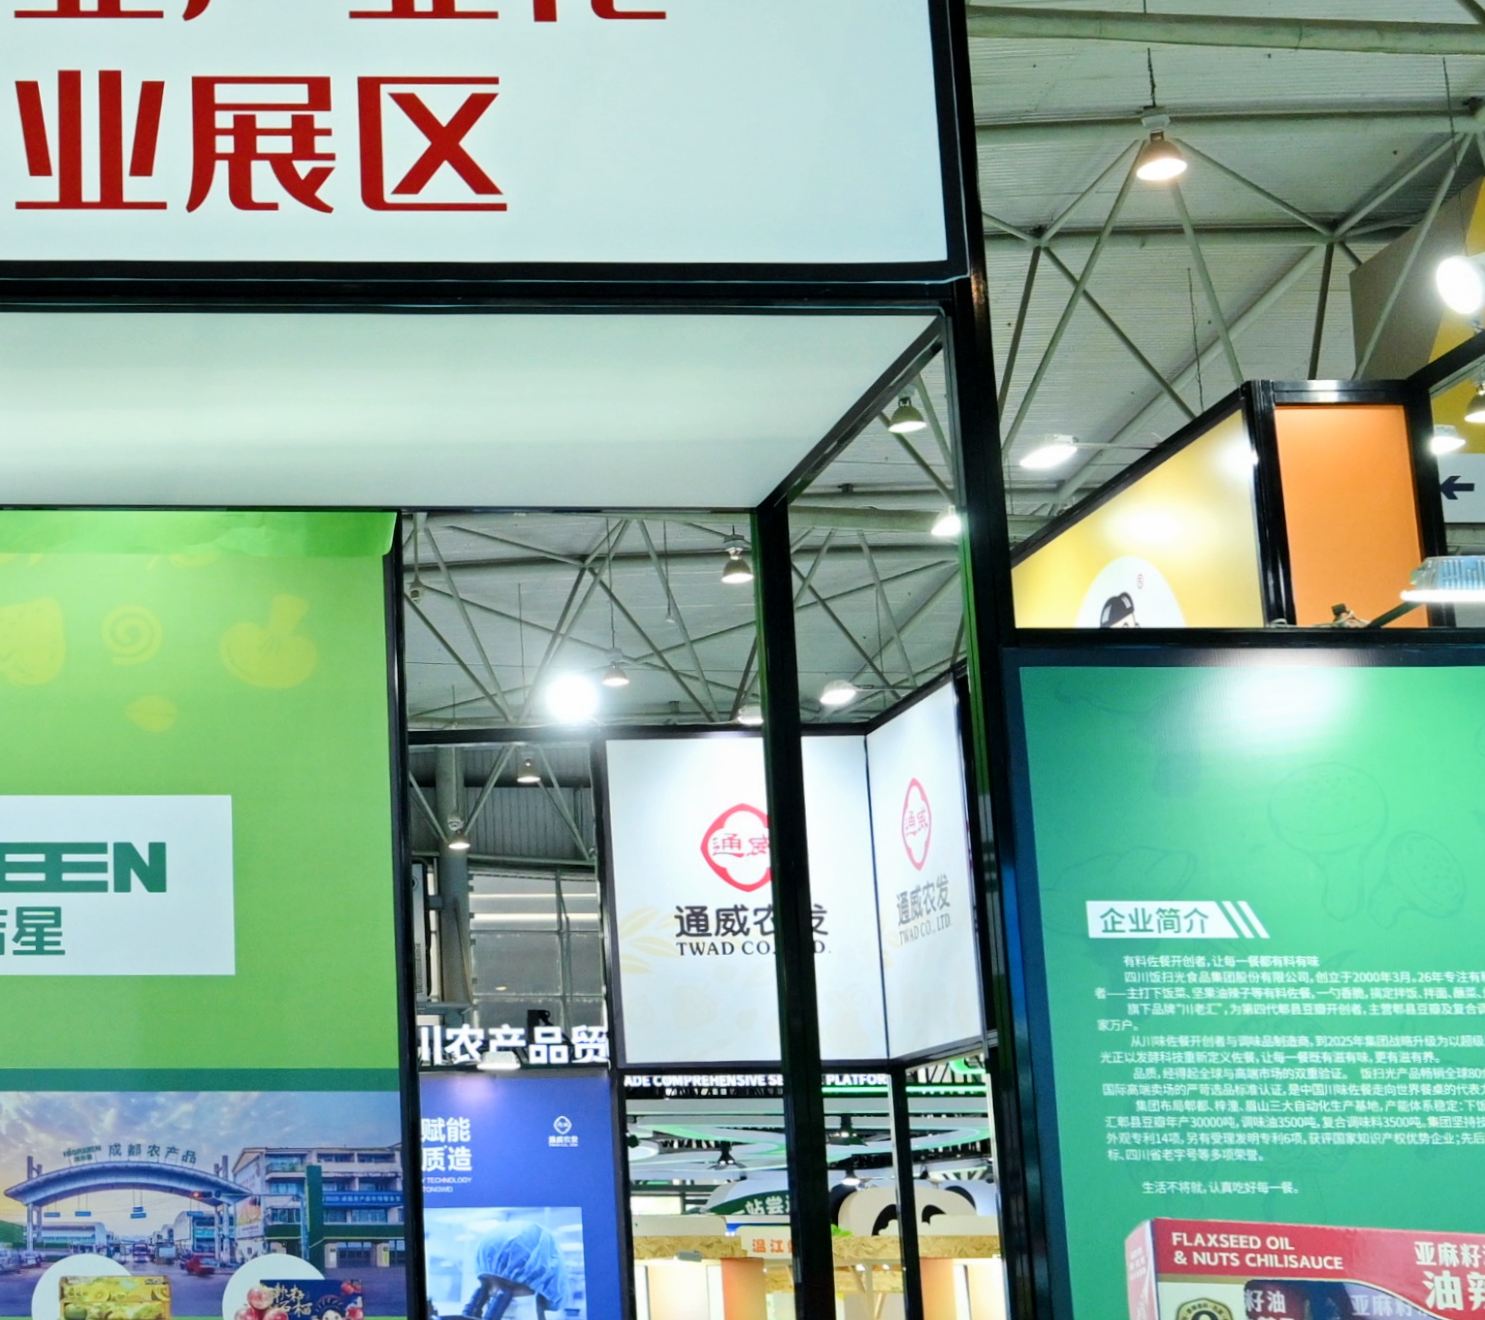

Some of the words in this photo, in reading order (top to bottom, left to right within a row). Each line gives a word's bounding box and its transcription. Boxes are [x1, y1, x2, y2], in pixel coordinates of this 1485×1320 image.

[896, 874, 951, 927] 通威农发
[1099, 907, 1211, 936] 企业简介
[676, 941, 734, 955] TWAD
[1097, 1019, 1139, 1032] 家万户。
[652, 1074, 765, 1087] COMPREHENSIVE
[108, 1143, 197, 1164] 成都农产品
[752, 1238, 793, 1253] 温江
[1172, 1231, 1261, 1250] FLAXSEED
[1266, 1235, 1295, 1251] OIL
[1174, 1250, 1188, 1265] &
[1192, 1252, 1240, 1267] NUTS
[1245, 1254, 1344, 1271] CHILISAUCE
